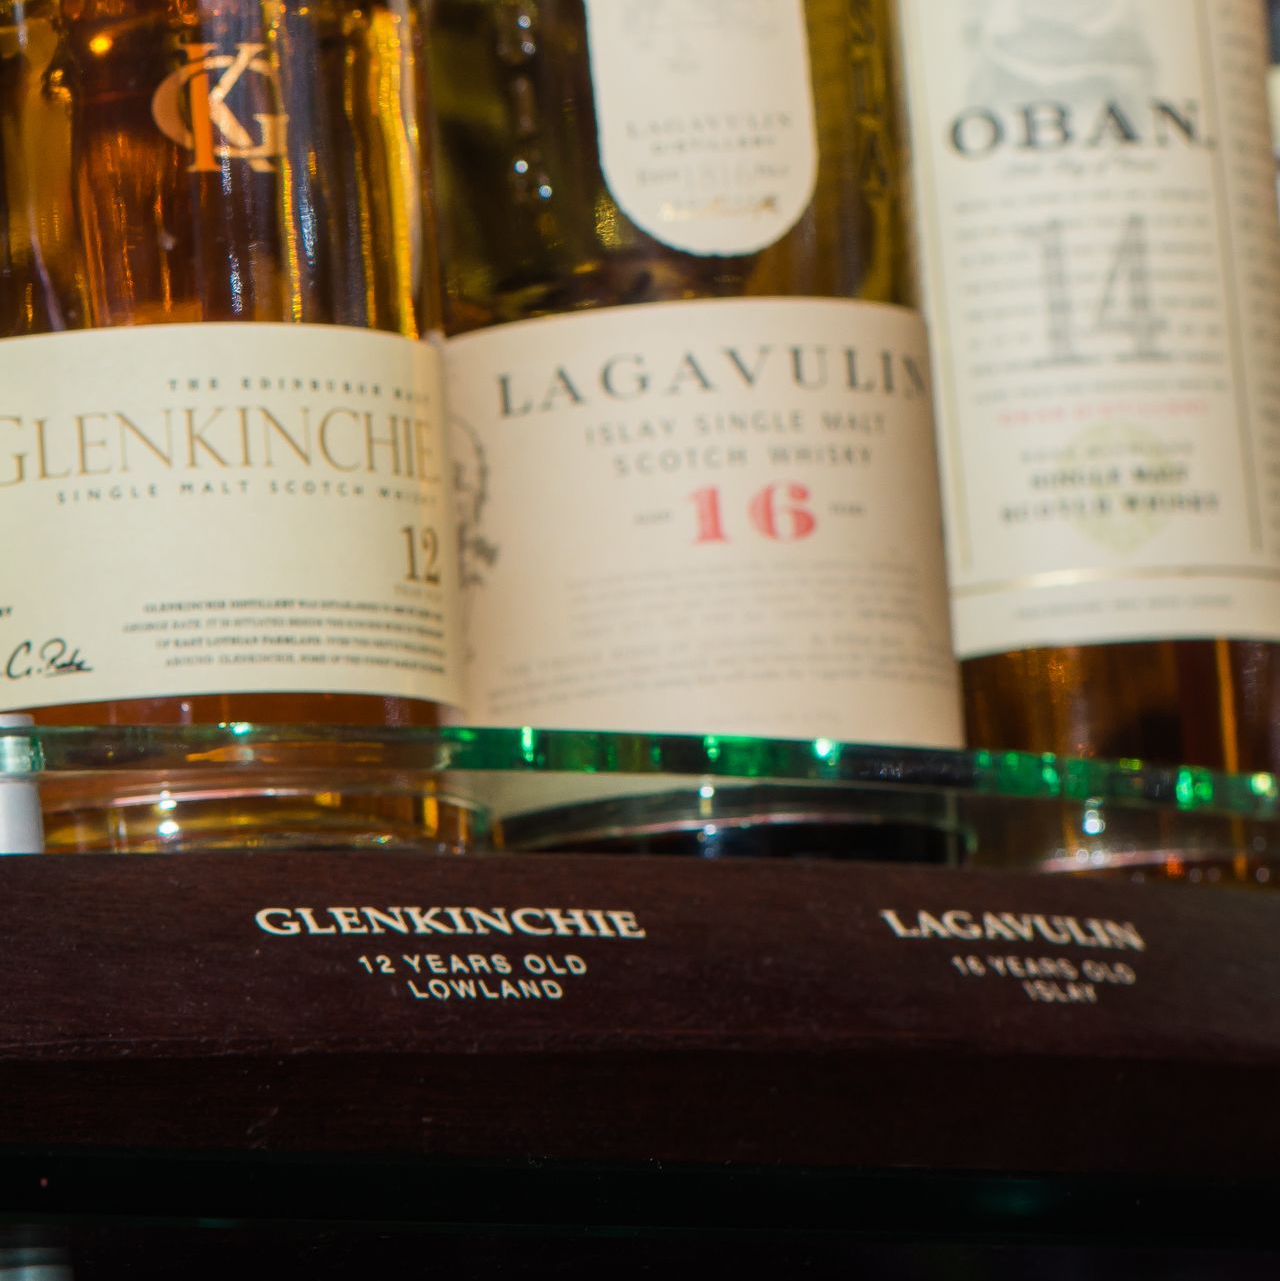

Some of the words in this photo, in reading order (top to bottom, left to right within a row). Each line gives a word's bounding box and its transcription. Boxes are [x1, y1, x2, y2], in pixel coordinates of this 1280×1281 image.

[949, 98, 1210, 157] OBAN
[1016, 211, 1170, 369] 14
[496, 344, 928, 418] LAGAVULIN
[585, 419, 676, 448] ISLAY
[696, 411, 803, 438] SINGLE
[613, 445, 749, 478] SCOTCH
[767, 443, 873, 468] WHISKY
[57, 483, 158, 506] SINGLE
[179, 480, 248, 496] MALT
[268, 480, 365, 497] SCOTCH
[687, 478, 818, 547] 16
[401, 524, 442, 587] 12
[253, 906, 647, 939] GLENKINCHIE
[878, 908, 1147, 953] LAGAVULIN
[357, 954, 396, 975] 12
[402, 953, 513, 975] YEARS
[523, 954, 588, 976] OLD
[950, 954, 987, 977] 16
[987, 954, 1079, 982] YEARS
[1081, 959, 1137, 986] OLD
[407, 979, 566, 1001] LOWLAND
[1021, 979, 1099, 1005] ISLAY
